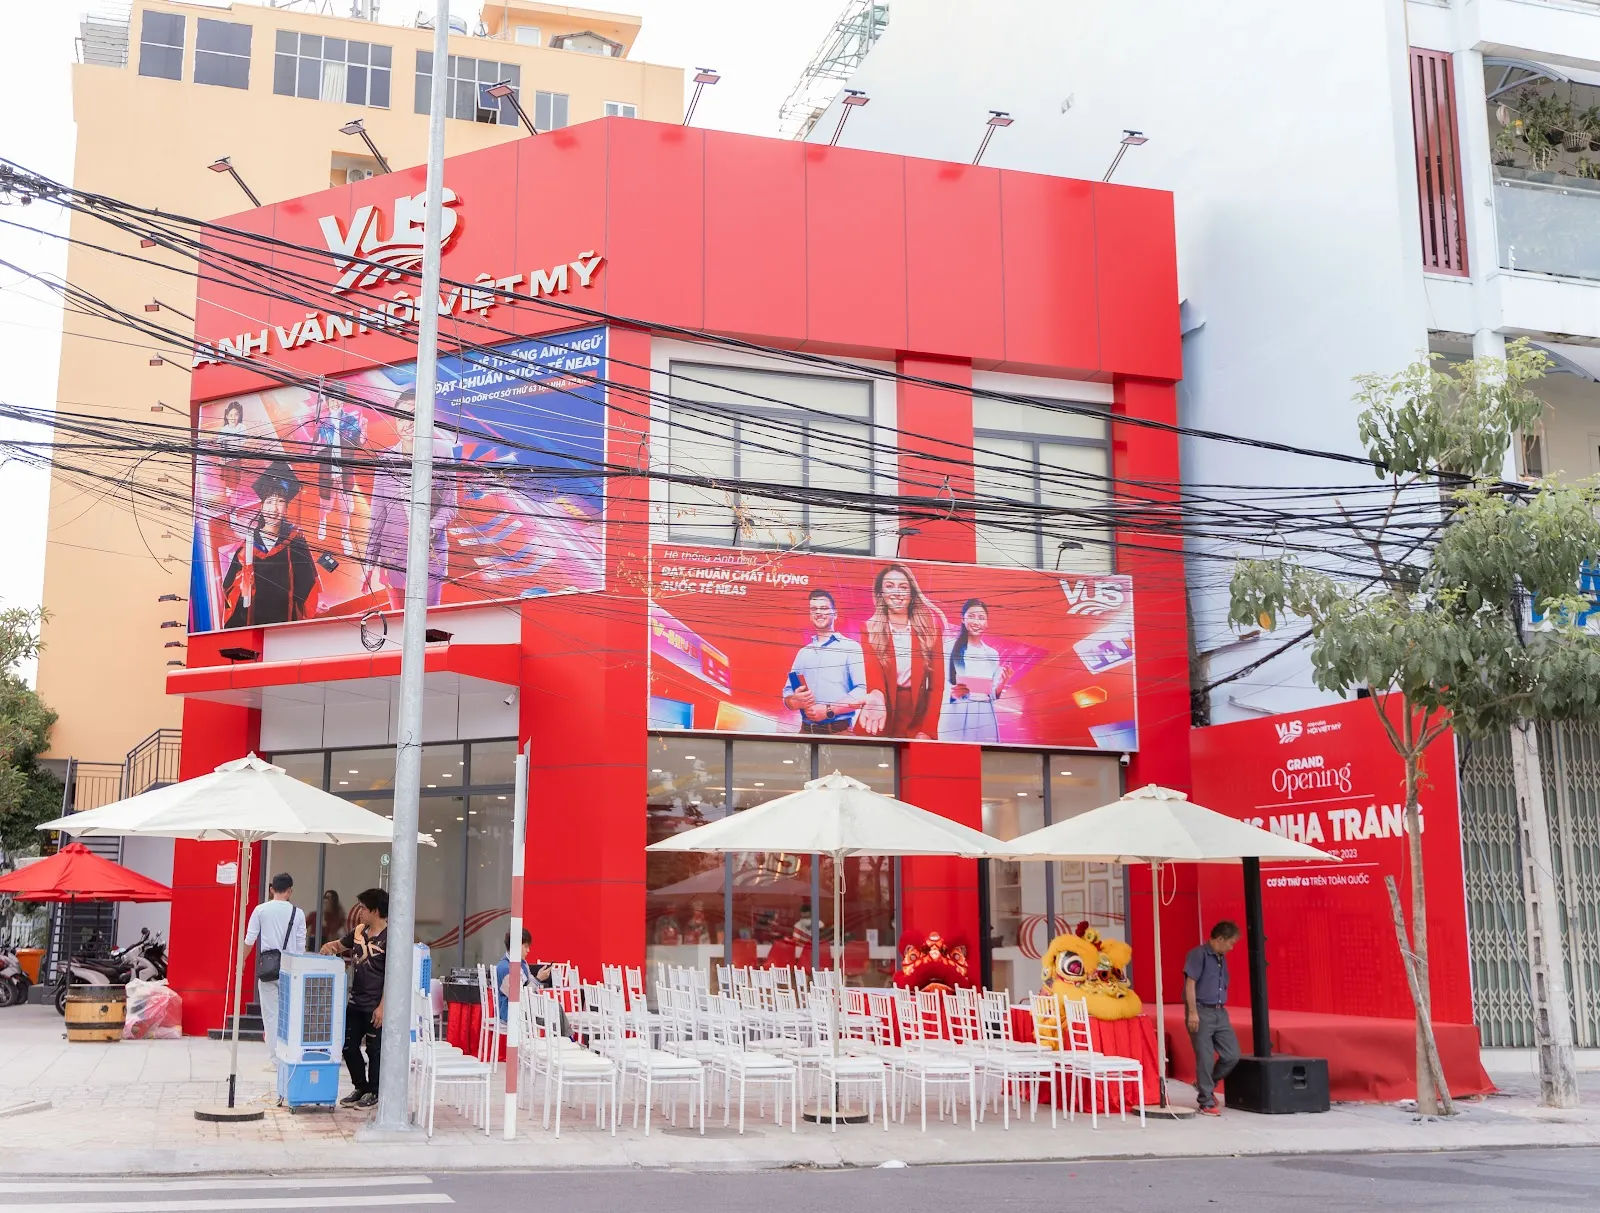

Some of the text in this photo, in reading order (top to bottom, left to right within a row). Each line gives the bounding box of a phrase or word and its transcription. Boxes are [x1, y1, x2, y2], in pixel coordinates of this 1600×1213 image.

[318, 187, 461, 276] VUS
[192, 329, 268, 368] ANH
[275, 311, 354, 349] VĂN
[530, 251, 603, 297] MỸ
[539, 342, 569, 359] ANH
[571, 334, 603, 352] NGỮ
[565, 353, 600, 370] NEAS
[529, 384, 538, 393] 63
[1059, 579, 1124, 609] VUS
[1275, 720, 1304, 740] VUS
[1287, 755, 1324, 771] GRAND
[1272, 763, 1352, 799] Opening
[1269, 812, 1325, 844] NHA
[1340, 848, 1358, 859] 2023
[1310, 875, 1327, 886] TRÊN
[1327, 874, 1347, 885] TOÀN
[1348, 872, 1370, 885] QUỐC
